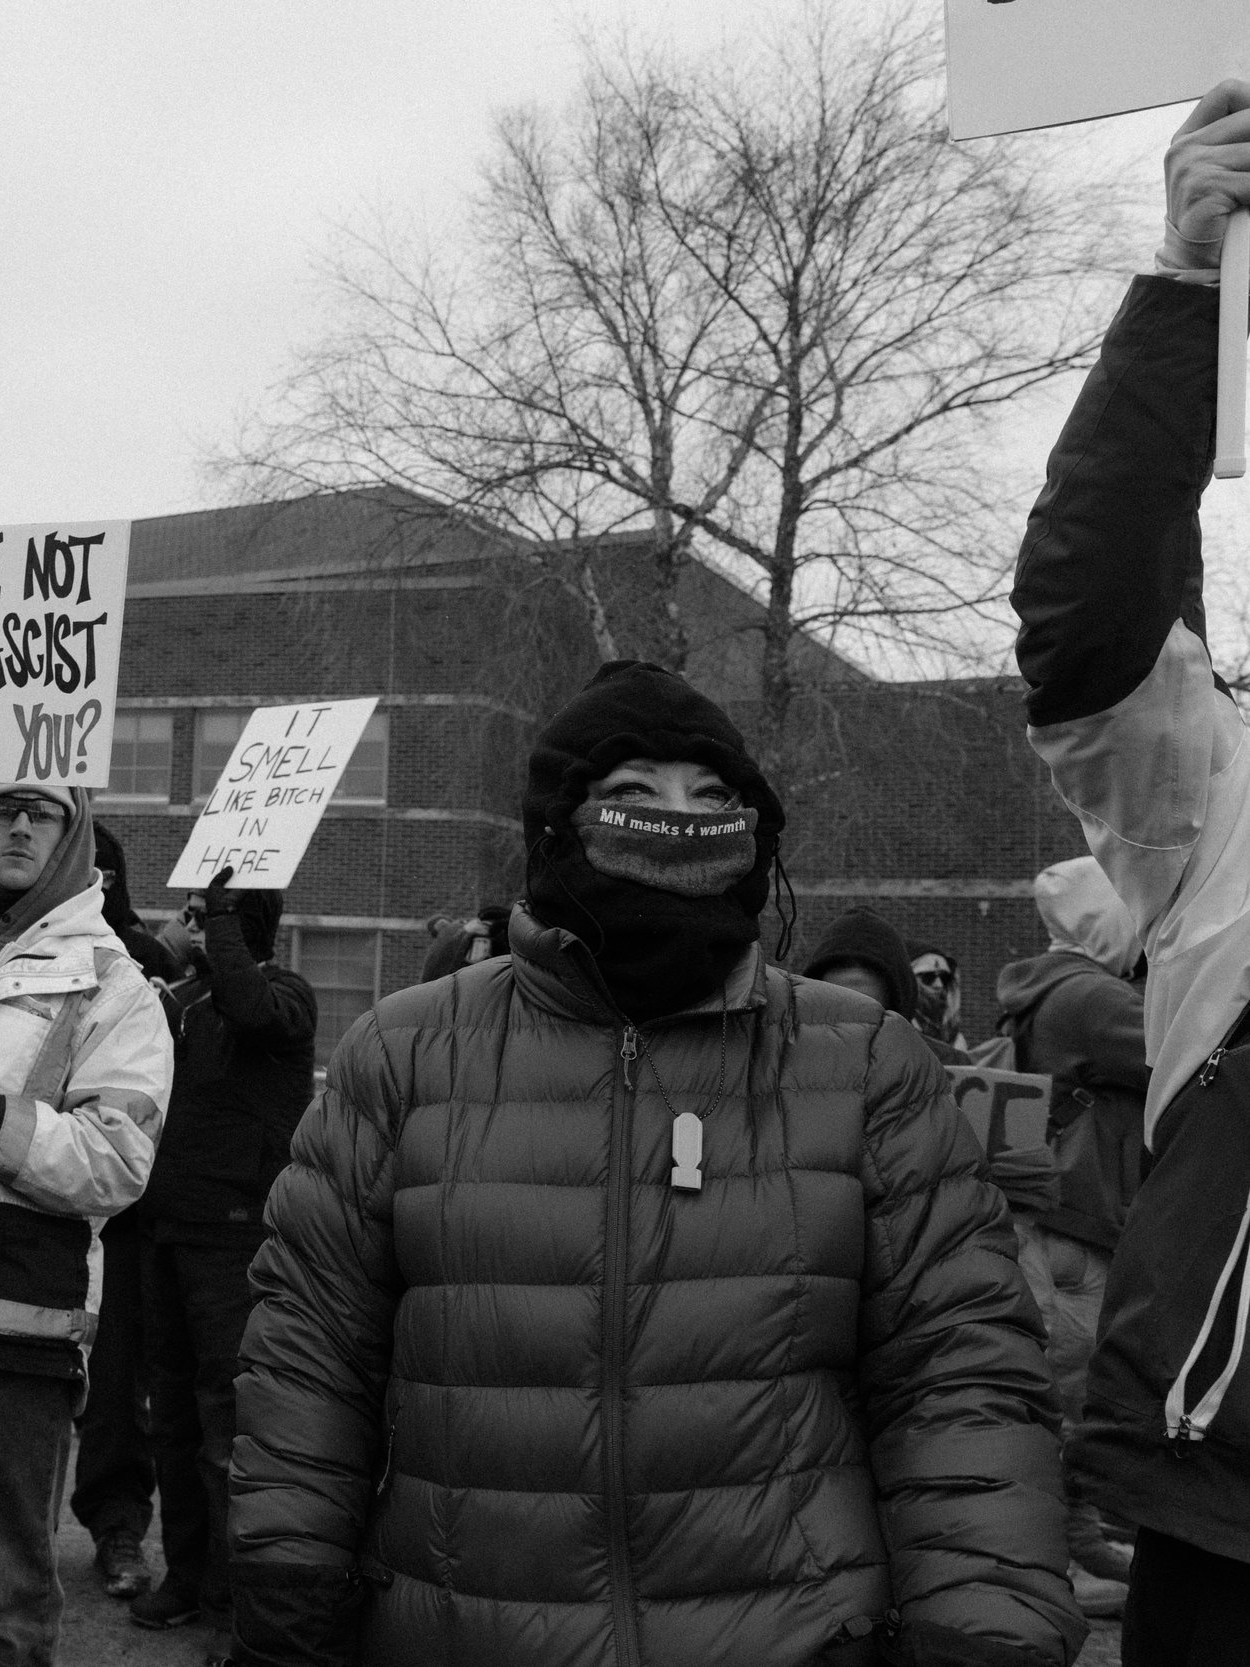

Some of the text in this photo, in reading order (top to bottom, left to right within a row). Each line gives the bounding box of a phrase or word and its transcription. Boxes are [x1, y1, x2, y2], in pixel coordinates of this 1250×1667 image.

[23, 531, 106, 605] NOT
[285, 707, 332, 738] IT
[13, 698, 102, 782] YOU?
[228, 742, 338, 783] SMELL
[203, 787, 325, 816] LIKE BITCH
[238, 817, 269, 838] IN
[600, 807, 746, 837] MN masks 4 warmth
[196, 845, 281, 876] HERE
